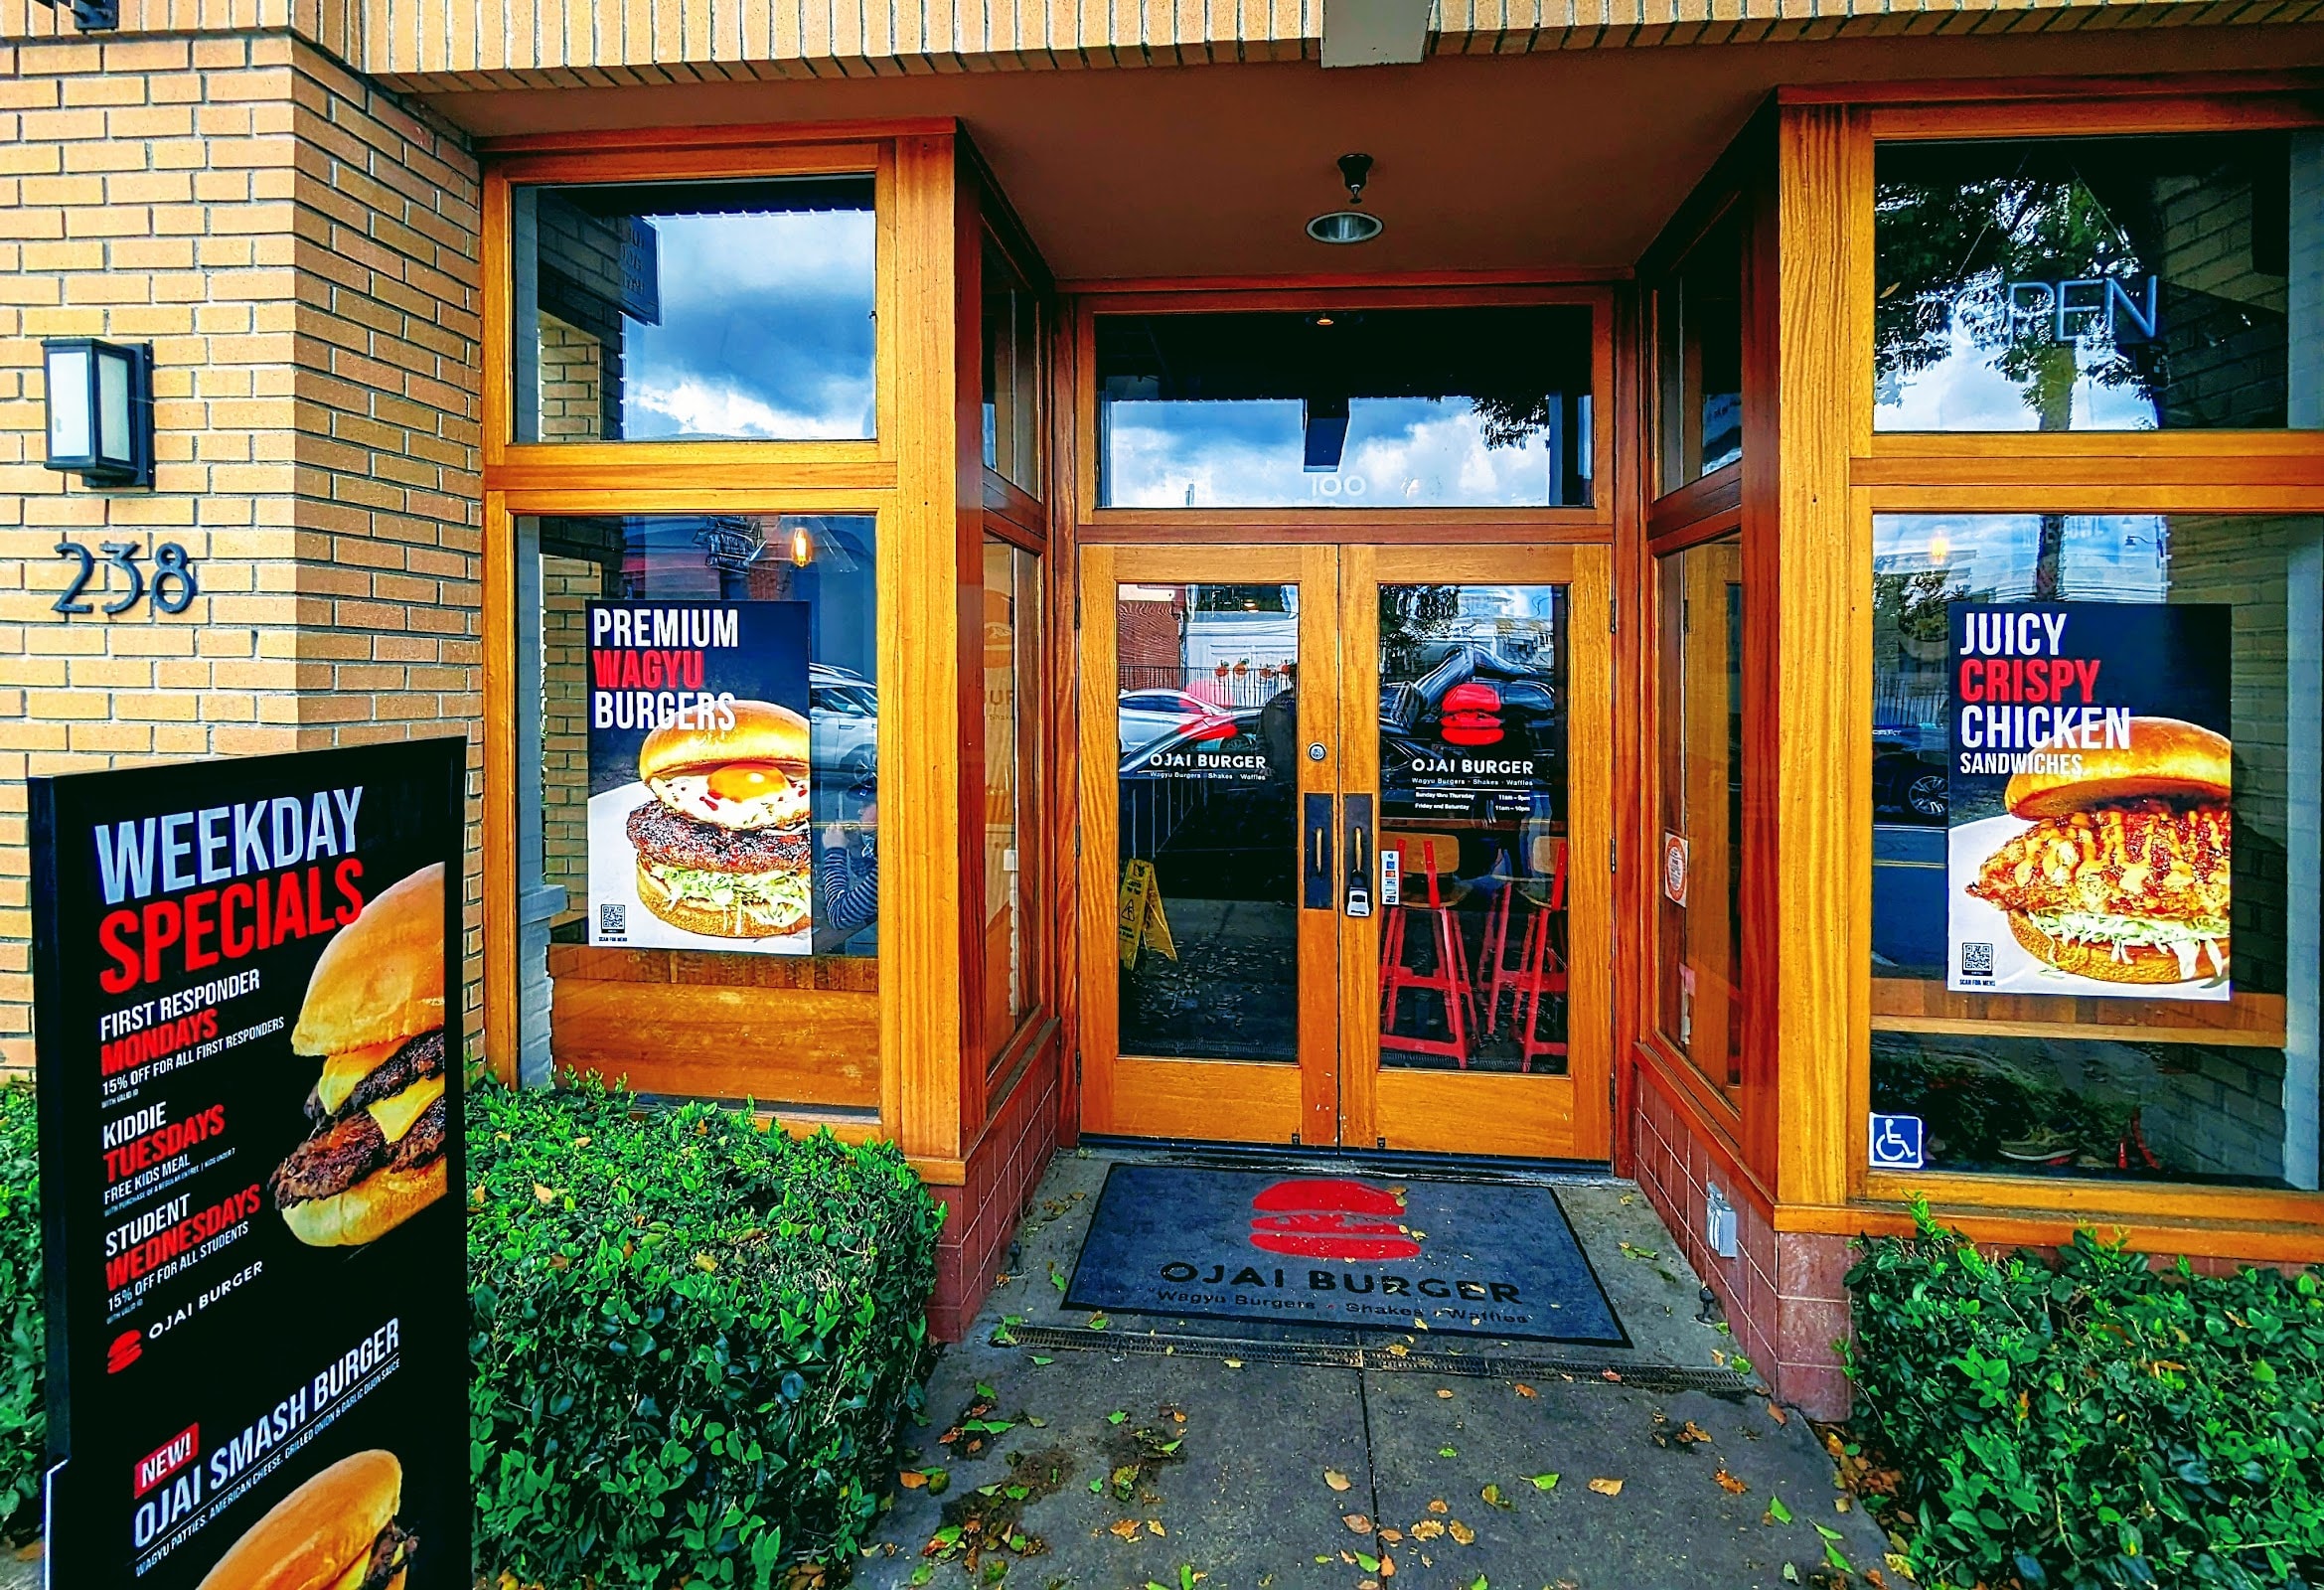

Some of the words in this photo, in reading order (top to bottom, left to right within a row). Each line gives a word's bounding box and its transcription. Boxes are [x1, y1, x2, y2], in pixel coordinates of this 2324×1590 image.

[1951, 274, 2157, 348] OPEN
[1312, 475, 1367, 497] 100
[51, 541, 197, 614] 238
[593, 608, 739, 648] PREMIUM
[1959, 612, 2068, 656] JUICY
[592, 649, 704, 689] WAGYU
[1959, 659, 2100, 704] CRISPY
[594, 691, 737, 731] BURGERS
[1960, 705, 2130, 750] CHICKEN
[1150, 753, 1191, 767] OJAI
[1197, 754, 1266, 769] BURGER
[1411, 758, 1456, 773] OJAI
[1462, 759, 1534, 774] BURGER
[1959, 752, 2084, 776] SANDWICHES
[94, 786, 364, 905] WEEKDAY
[99, 858, 365, 994] SPECIALS
[100, 1001, 155, 1041] FIRST
[160, 968, 260, 1022] RESPONDER
[100, 1008, 219, 1076] MONDAYS
[102, 1074, 128, 1096] 15%
[130, 1065, 150, 1085] OFF
[153, 1057, 173, 1077] FOR
[175, 1049, 195, 1068] ALL
[196, 1038, 224, 1061] FIRST
[226, 1016, 285, 1049] RESPONDERS
[102, 1104, 226, 1184] TUESDAYS
[103, 1100, 167, 1149] KIDDIE
[104, 1179, 132, 1204] FREE
[134, 1166, 160, 1191] KIDS
[162, 1153, 191, 1178] MEAL
[105, 1192, 191, 1257] STUDENT
[105, 1184, 261, 1292] WEDNESDAYS
[107, 1286, 133, 1312] 15%
[134, 1273, 155, 1296] OFF
[157, 1261, 178, 1284] FOR
[179, 1250, 198, 1271] ALL
[200, 1220, 248, 1258] STUDENTS
[1160, 1261, 1285, 1288] OJAI
[1309, 1270, 1523, 1304] BURGER
[148, 1302, 193, 1339] OJAI
[199, 1260, 263, 1310] BURGER
[1158, 1290, 1226, 1305] Wagyu
[1235, 1294, 1317, 1310] Burgers
[1345, 1302, 1424, 1318] Shakes
[1448, 1308, 1528, 1324] Waffles
[134, 1464, 201, 1548] OJAI
[210, 1385, 306, 1490] SMASH
[313, 1317, 399, 1412] BURGER
[141, 1432, 192, 1489] NEW!
[135, 1542, 170, 1577] WAGYU
[209, 1478, 251, 1520] AMERICAN
[284, 1428, 314, 1460] GRILLED
[314, 1411, 335, 1435] ONION
[381, 1357, 400, 1380] SAUCE
